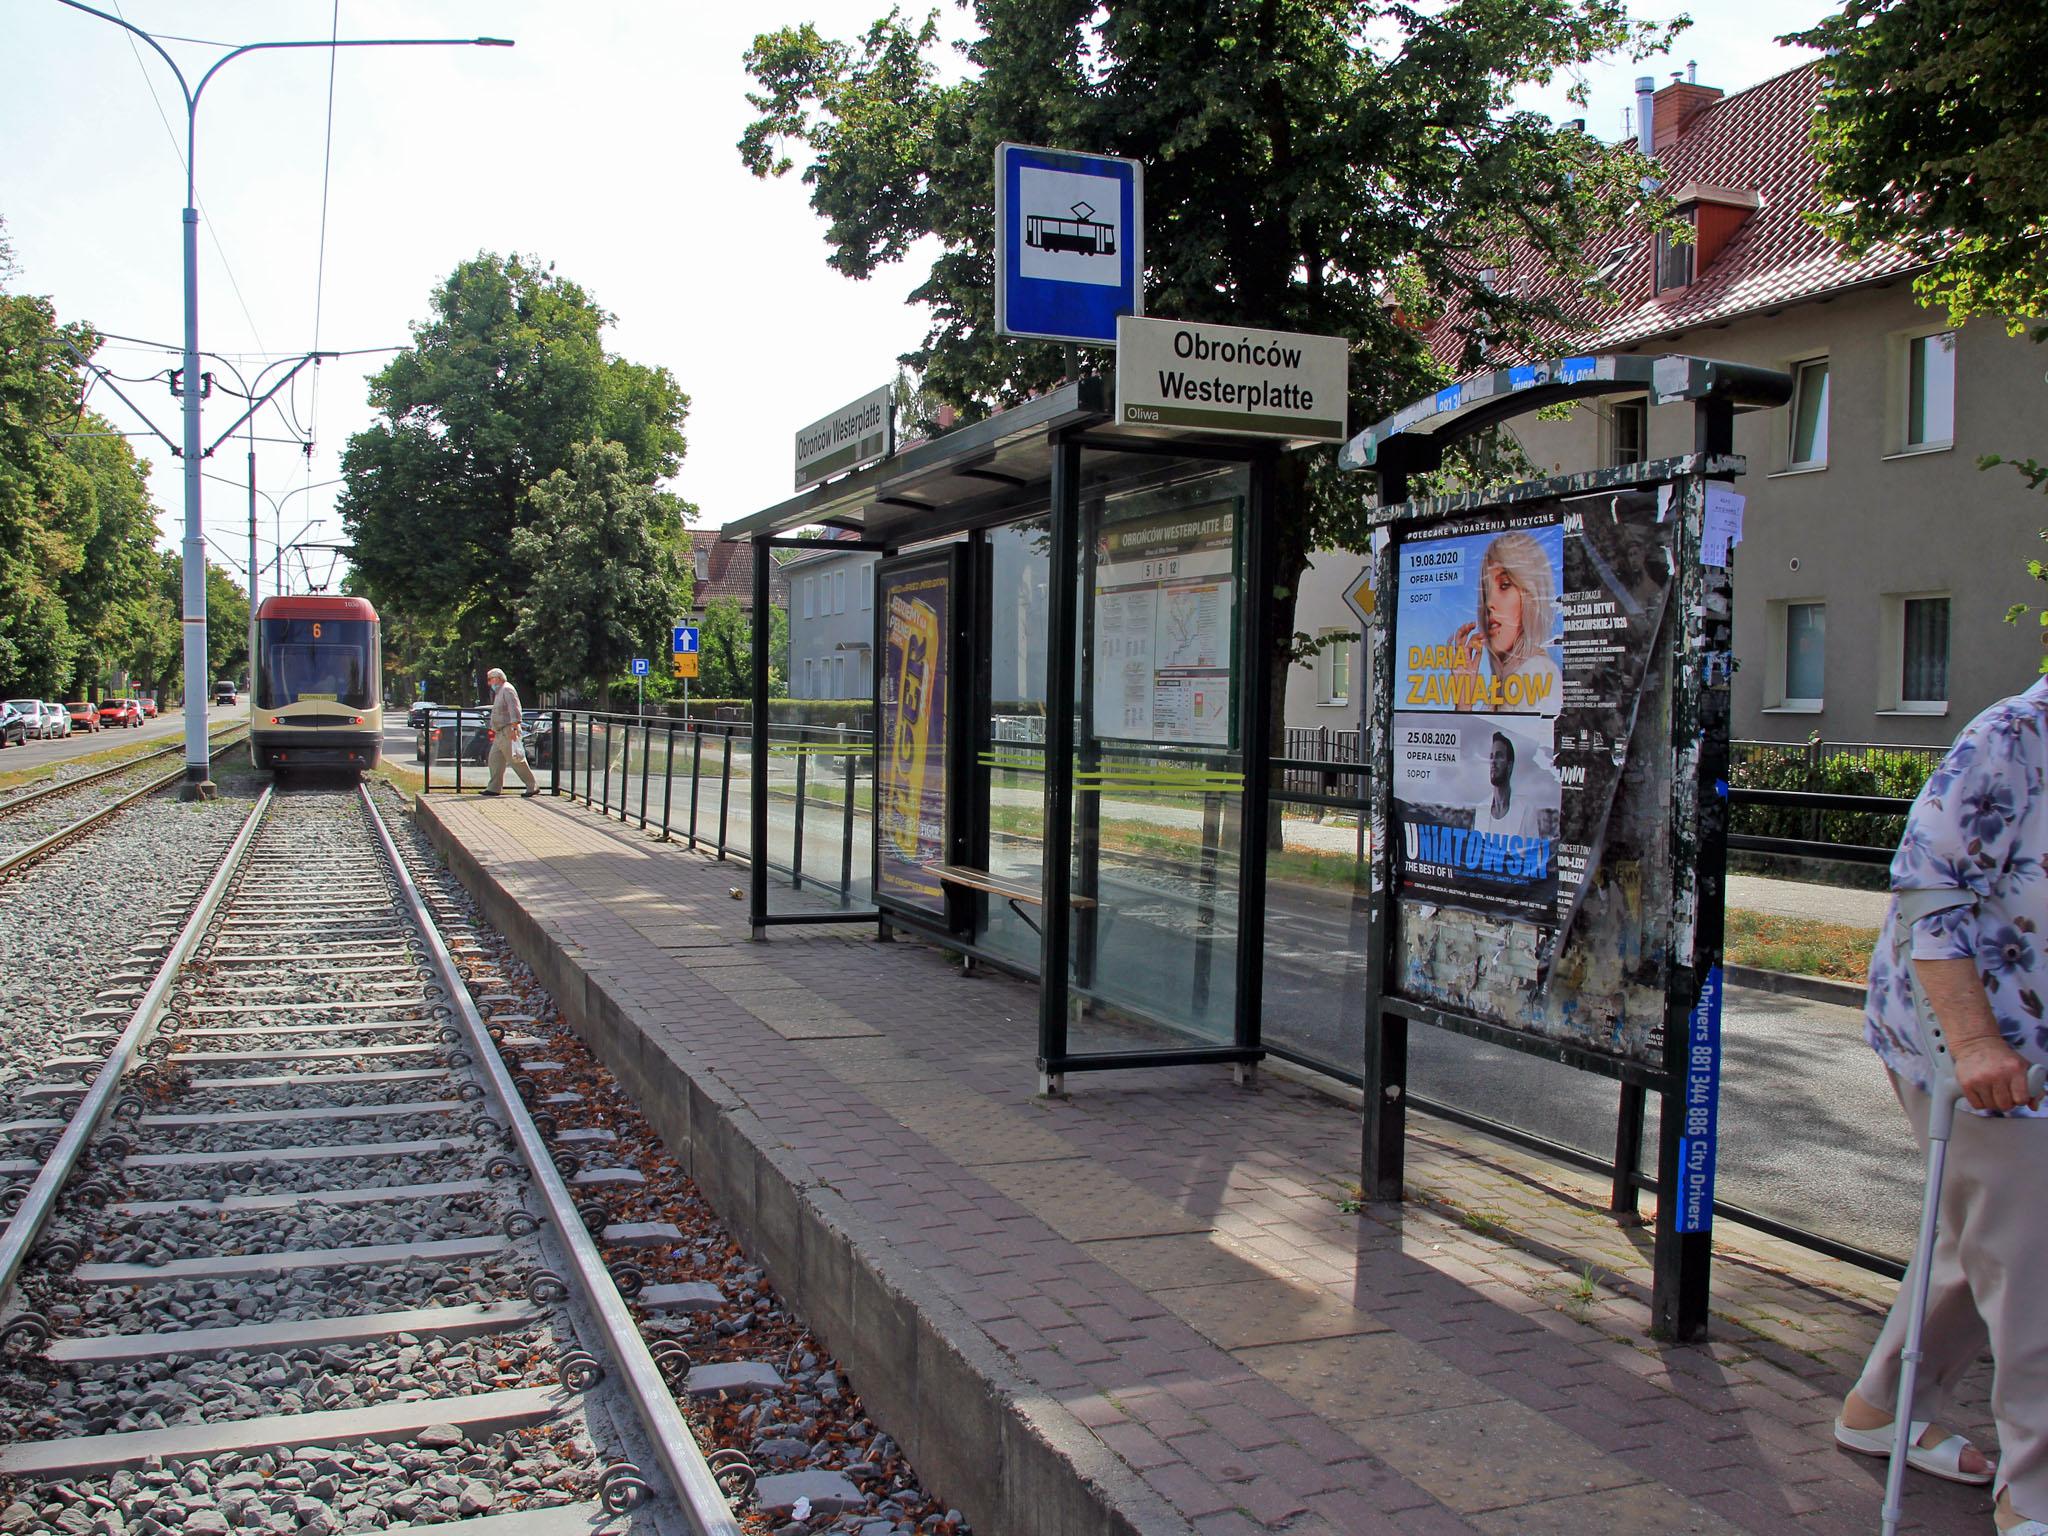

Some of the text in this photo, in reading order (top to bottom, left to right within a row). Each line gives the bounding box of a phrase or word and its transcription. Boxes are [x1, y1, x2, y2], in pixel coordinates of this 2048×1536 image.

[1174, 331, 1302, 369] Obrońców
[1159, 370, 1314, 412] Westerplatte
[1127, 407, 1160, 421] Oliwa
[797, 402, 881, 461] Obrońców Westerplatte
[1122, 528, 1163, 547] OBROŃCÓW
[1163, 518, 1220, 540] WESTERPLATTE
[1407, 513, 1555, 541] POLECANE WYDARZENIA MUZYCZNE
[1410, 551, 1459, 568] 19.08.2020
[1146, 561, 1177, 577] 5 6 12
[1410, 570, 1459, 585] OPERA LEŚNA
[1410, 593, 1433, 604] SOPOT
[1562, 603, 1592, 617] 00-LECIA
[313, 623, 321, 639] 6
[1408, 645, 1468, 670] DARIA
[636, 660, 646, 674] P
[1406, 672, 1553, 706] ZAWIAŁOW
[1407, 732, 1457, 746] 25.08.2020
[1407, 751, 1456, 763] OPERA LEŚNA
[1407, 769, 1431, 779] SOPOT
[1404, 821, 1551, 880] UNIATOWSKI
[1558, 843, 1579, 854] ONCERT
[1405, 861, 1418, 873] THE
[1418, 863, 1436, 877] BEST
[1436, 866, 1447, 878] OF
[1686, 984, 1714, 1231] Drivers 881 344 886 City Drivers
